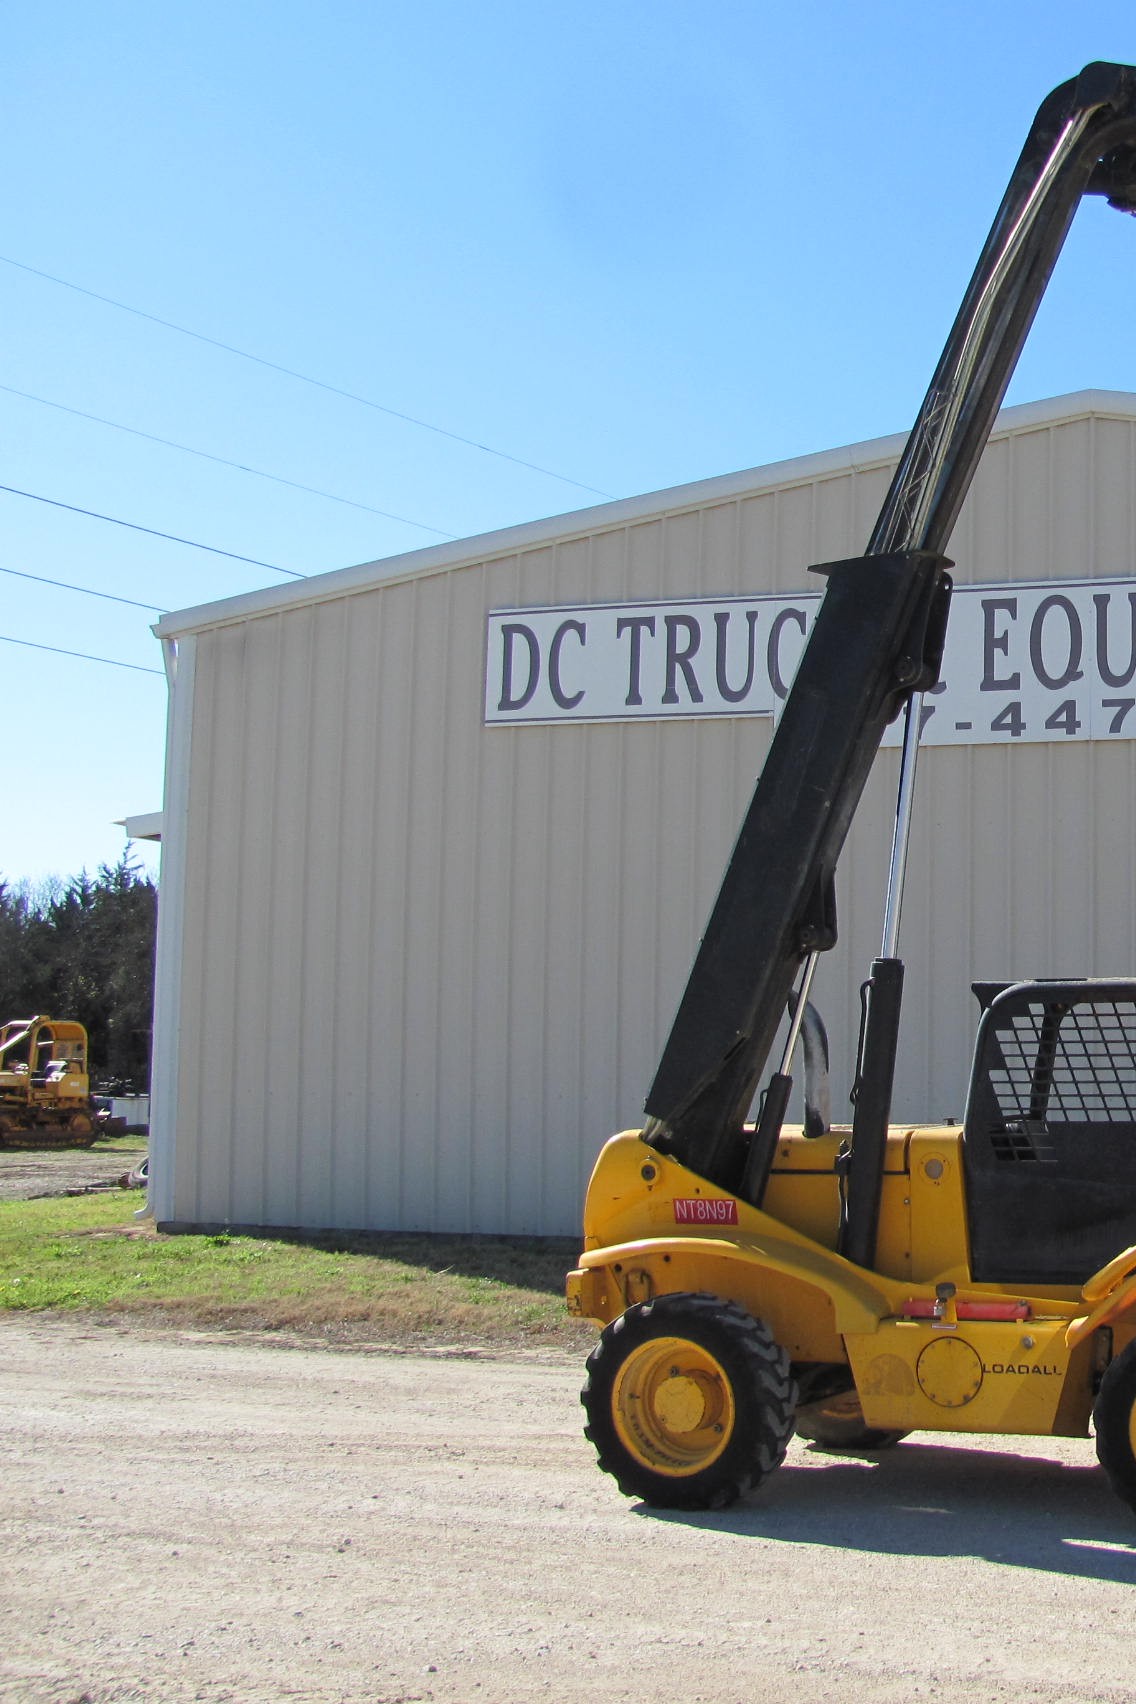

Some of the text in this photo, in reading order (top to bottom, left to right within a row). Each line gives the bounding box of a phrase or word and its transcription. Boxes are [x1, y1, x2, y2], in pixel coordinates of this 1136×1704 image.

[497, 618, 587, 711] DC
[616, 607, 807, 705] TRUC
[675, 1199, 734, 1220] NT8N97
[983, 1363, 1063, 1376] LOADALL
